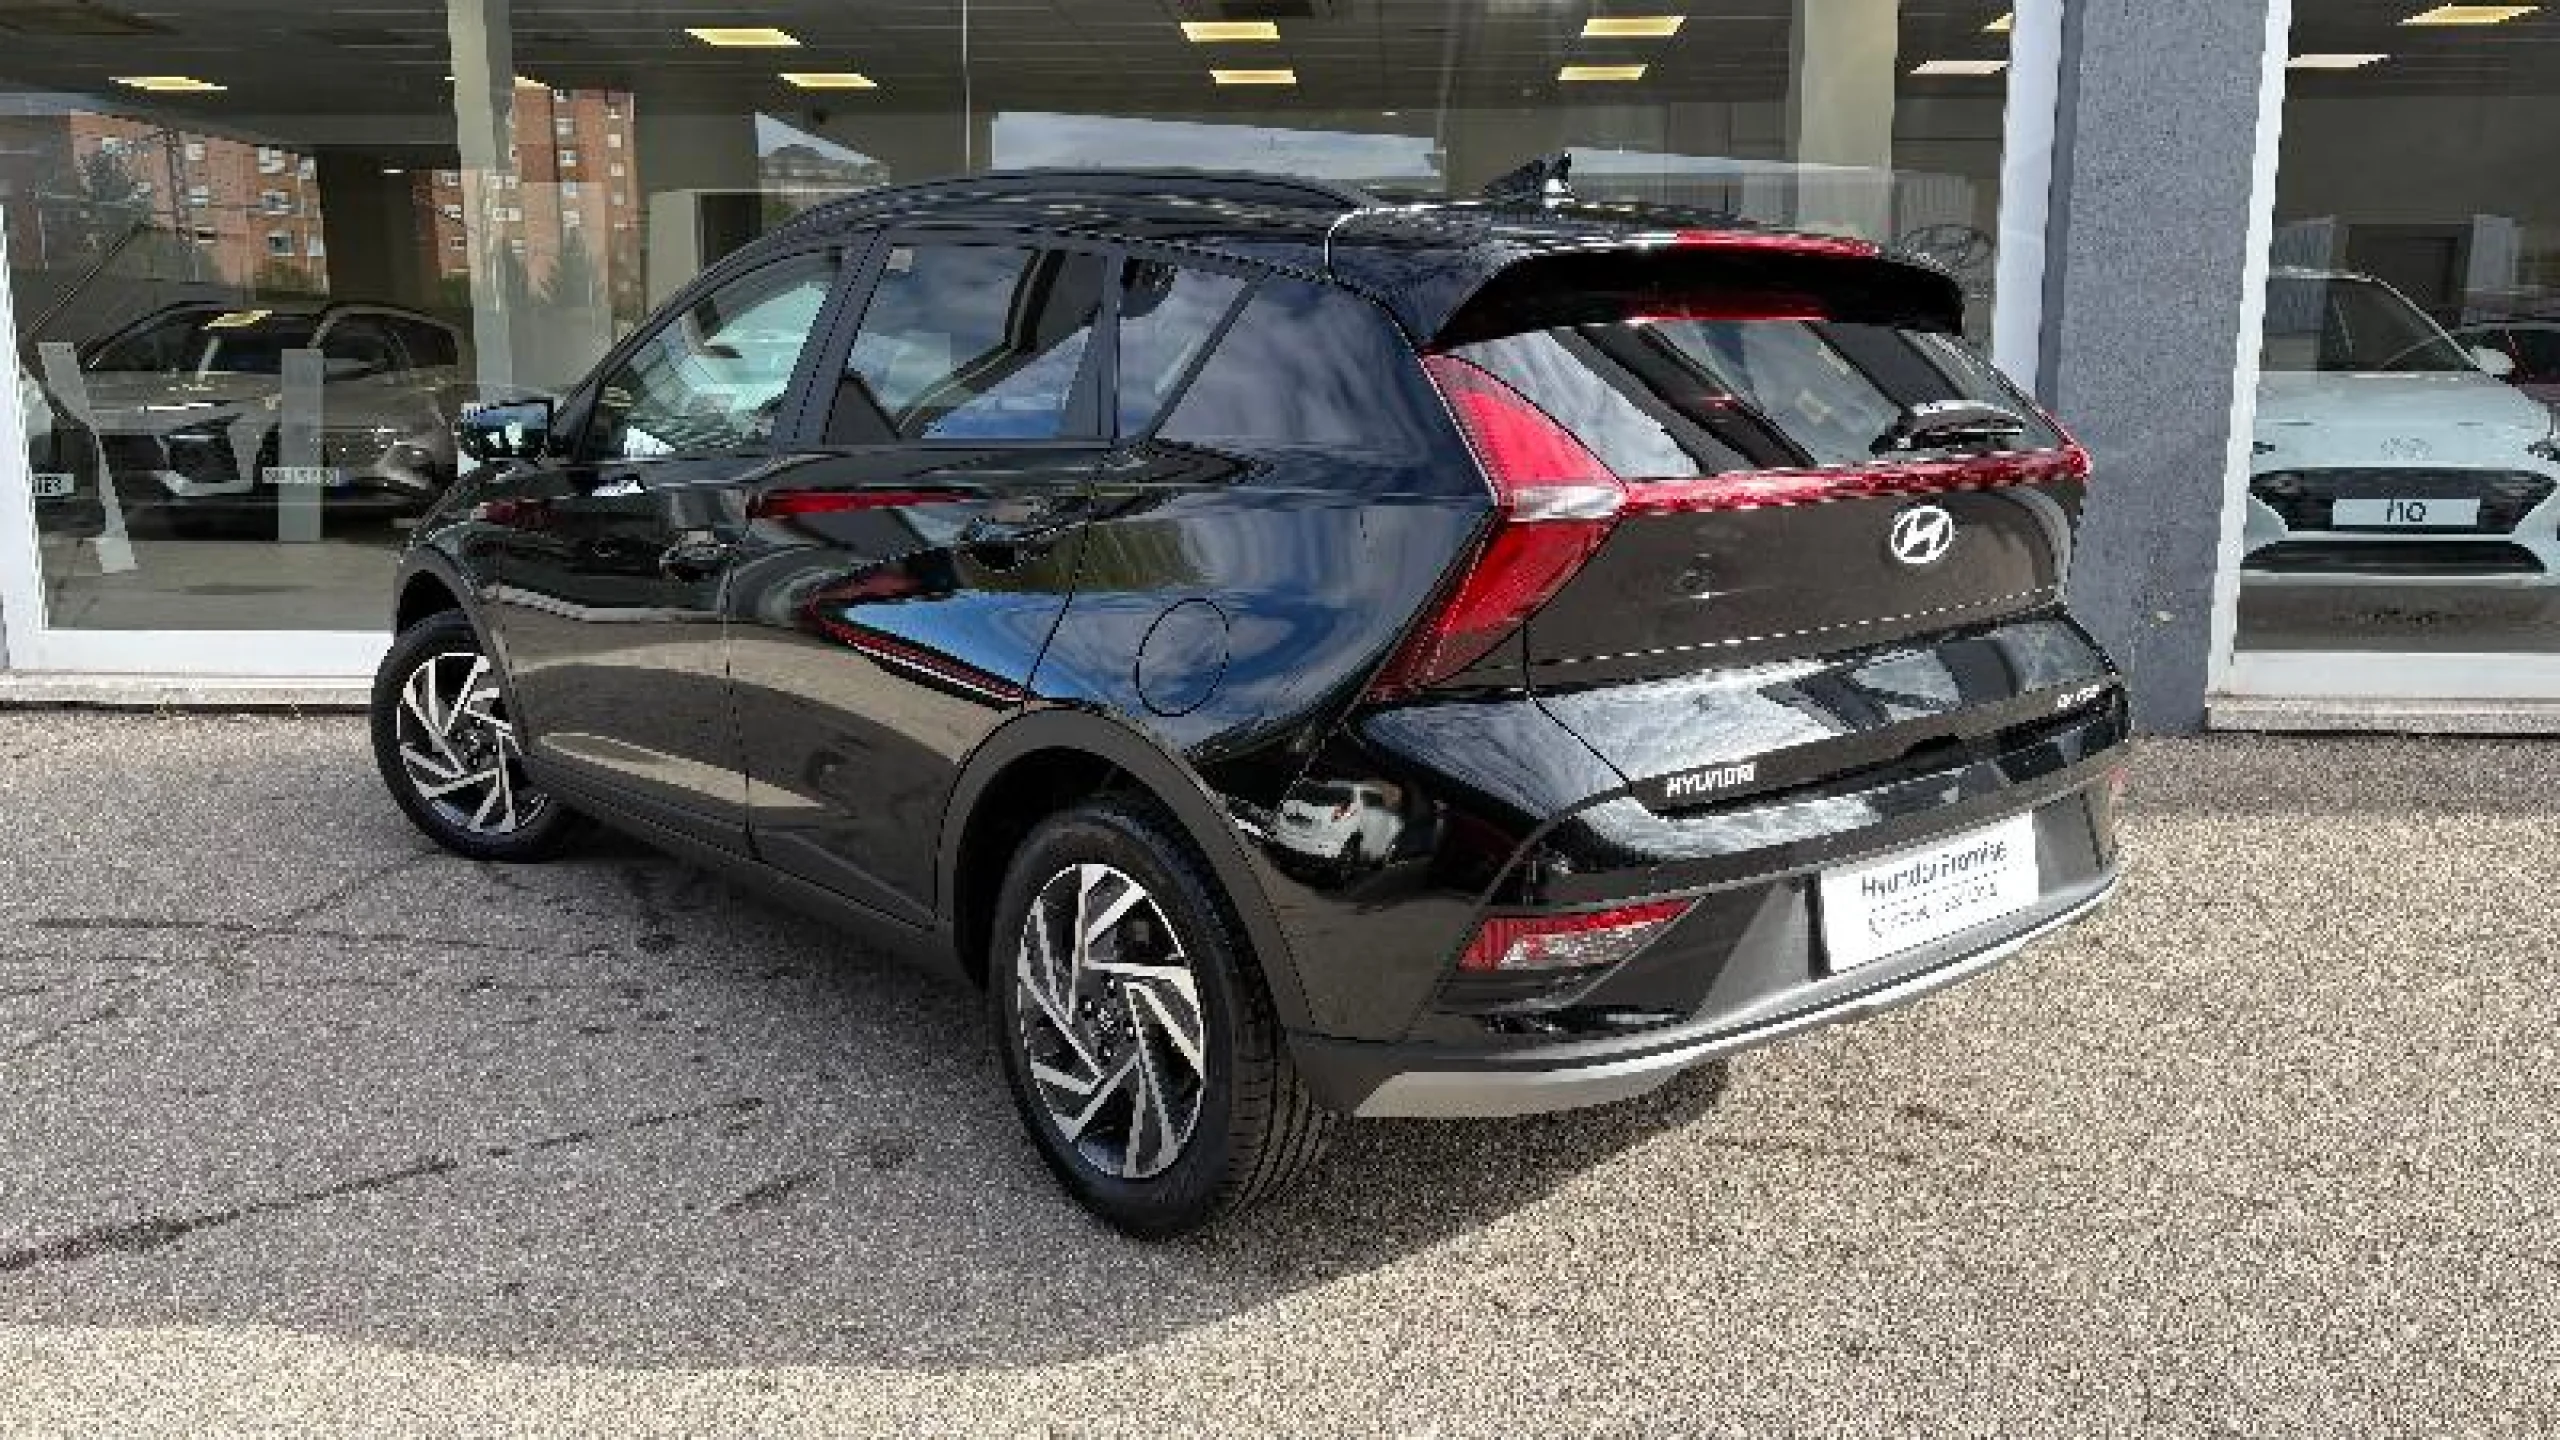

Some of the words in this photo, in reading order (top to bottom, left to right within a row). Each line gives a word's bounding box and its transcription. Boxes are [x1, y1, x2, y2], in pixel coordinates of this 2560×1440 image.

[1666, 763, 1757, 797] HYUNDAI
[1862, 860, 1937, 898] Hyundai
[1941, 841, 2007, 878] Promise
